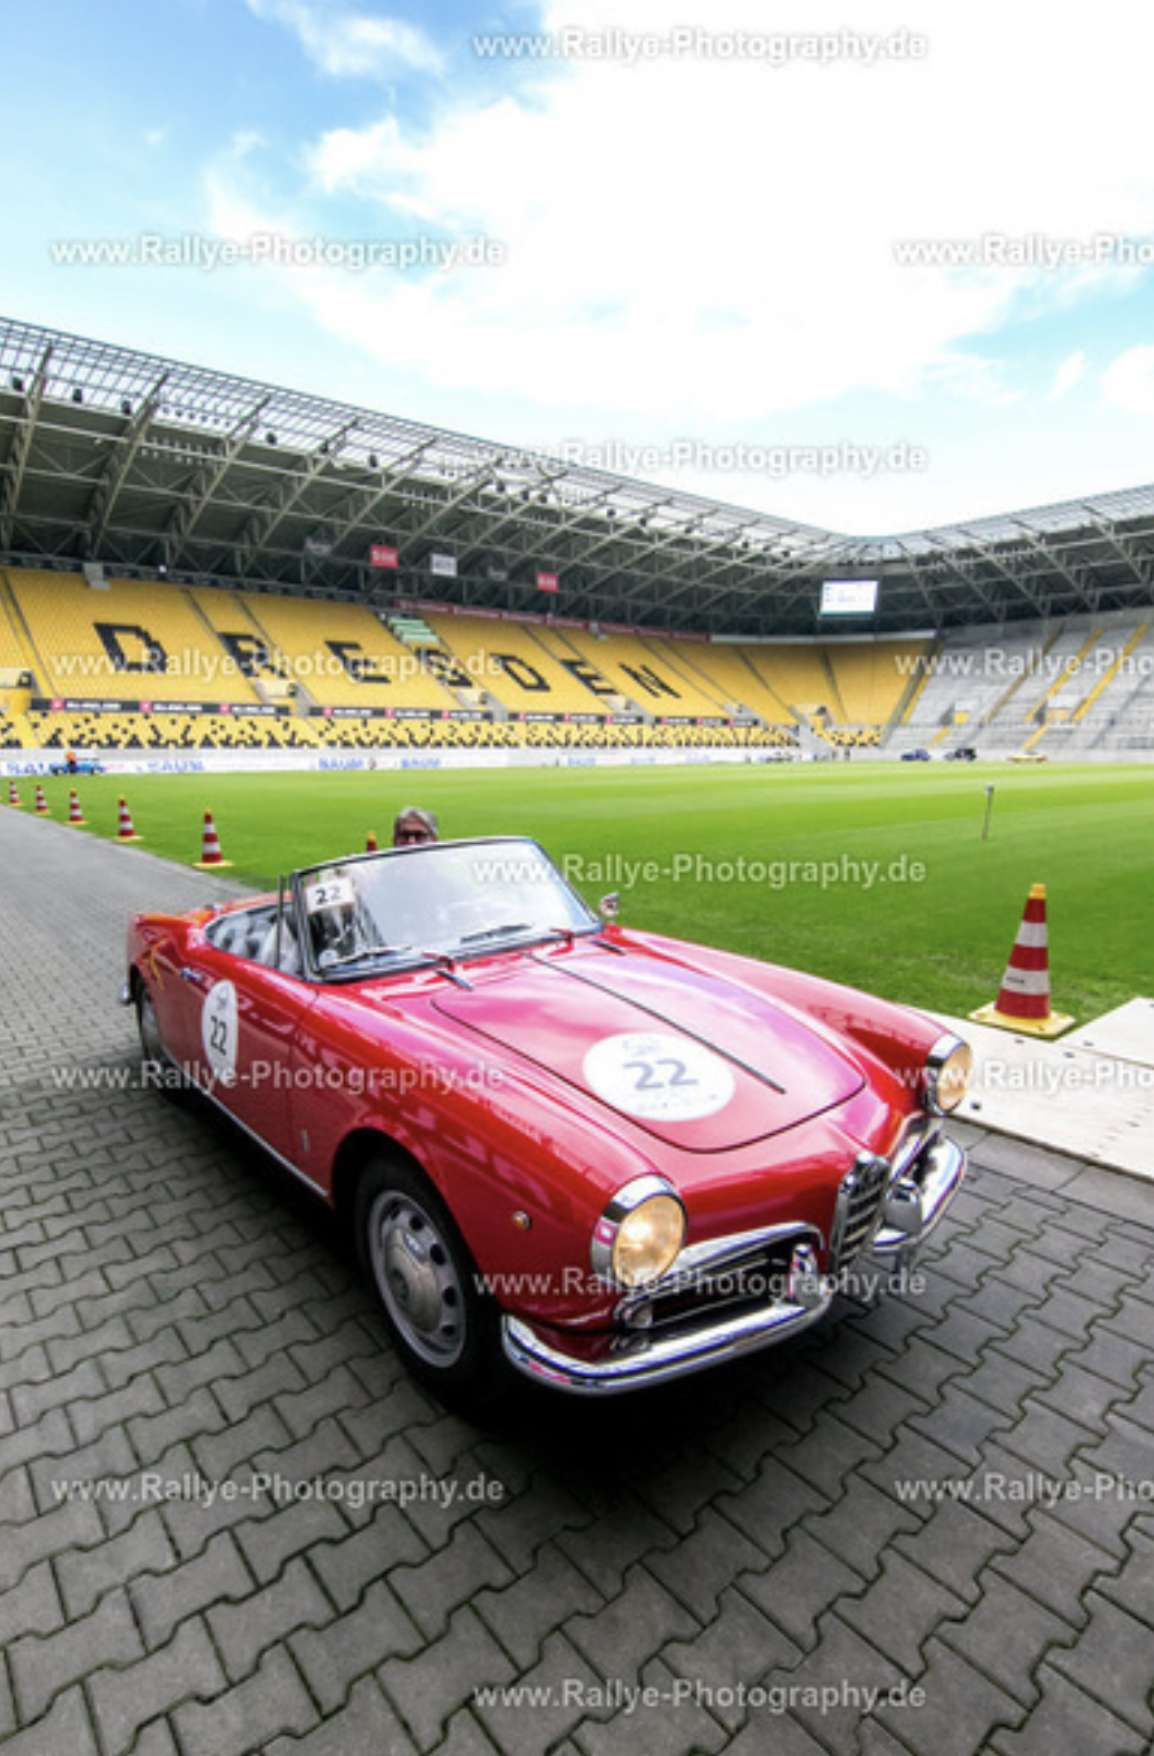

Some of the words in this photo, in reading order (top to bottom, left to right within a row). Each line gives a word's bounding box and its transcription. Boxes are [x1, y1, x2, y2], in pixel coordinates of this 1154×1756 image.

[93, 622, 681, 699] DRESDEN
[210, 1015, 227, 1056] 22
[622, 1058, 698, 1090] 22
